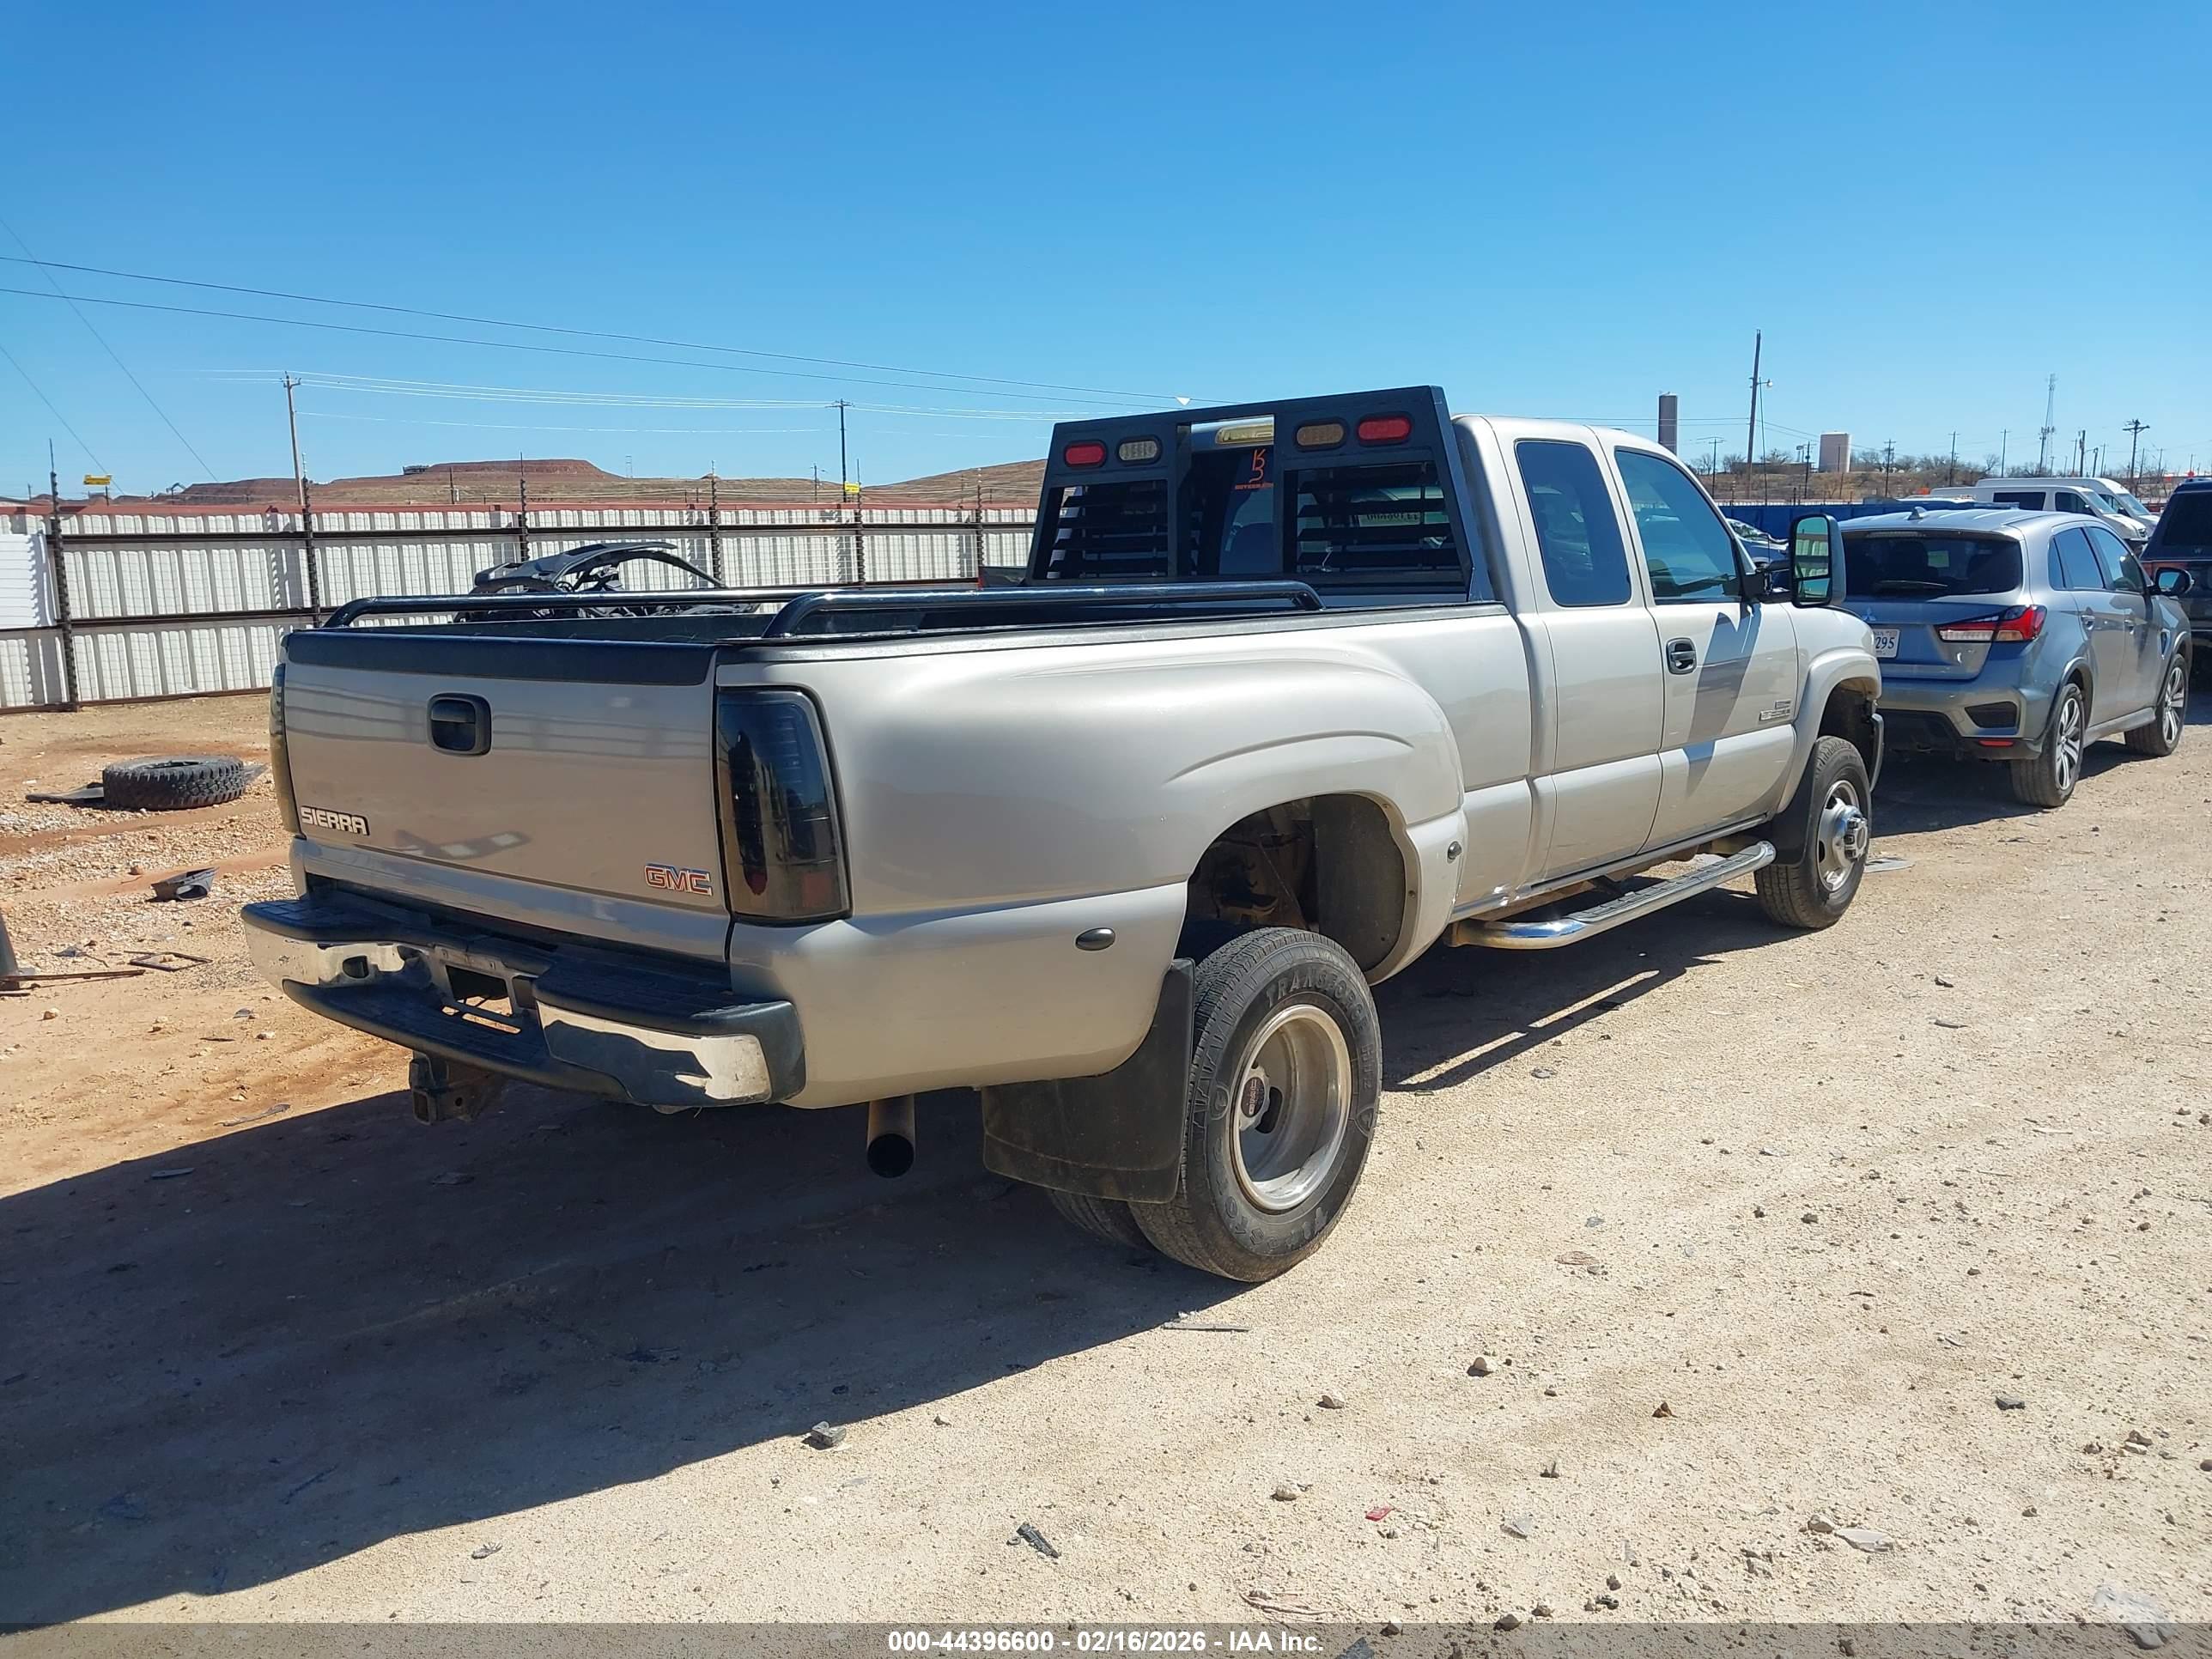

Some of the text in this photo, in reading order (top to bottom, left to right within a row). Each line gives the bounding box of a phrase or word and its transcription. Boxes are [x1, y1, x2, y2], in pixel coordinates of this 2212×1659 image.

[1875, 636, 1896, 649] 295
[301, 805, 369, 836] SIERRA
[645, 864, 713, 896] GMC
